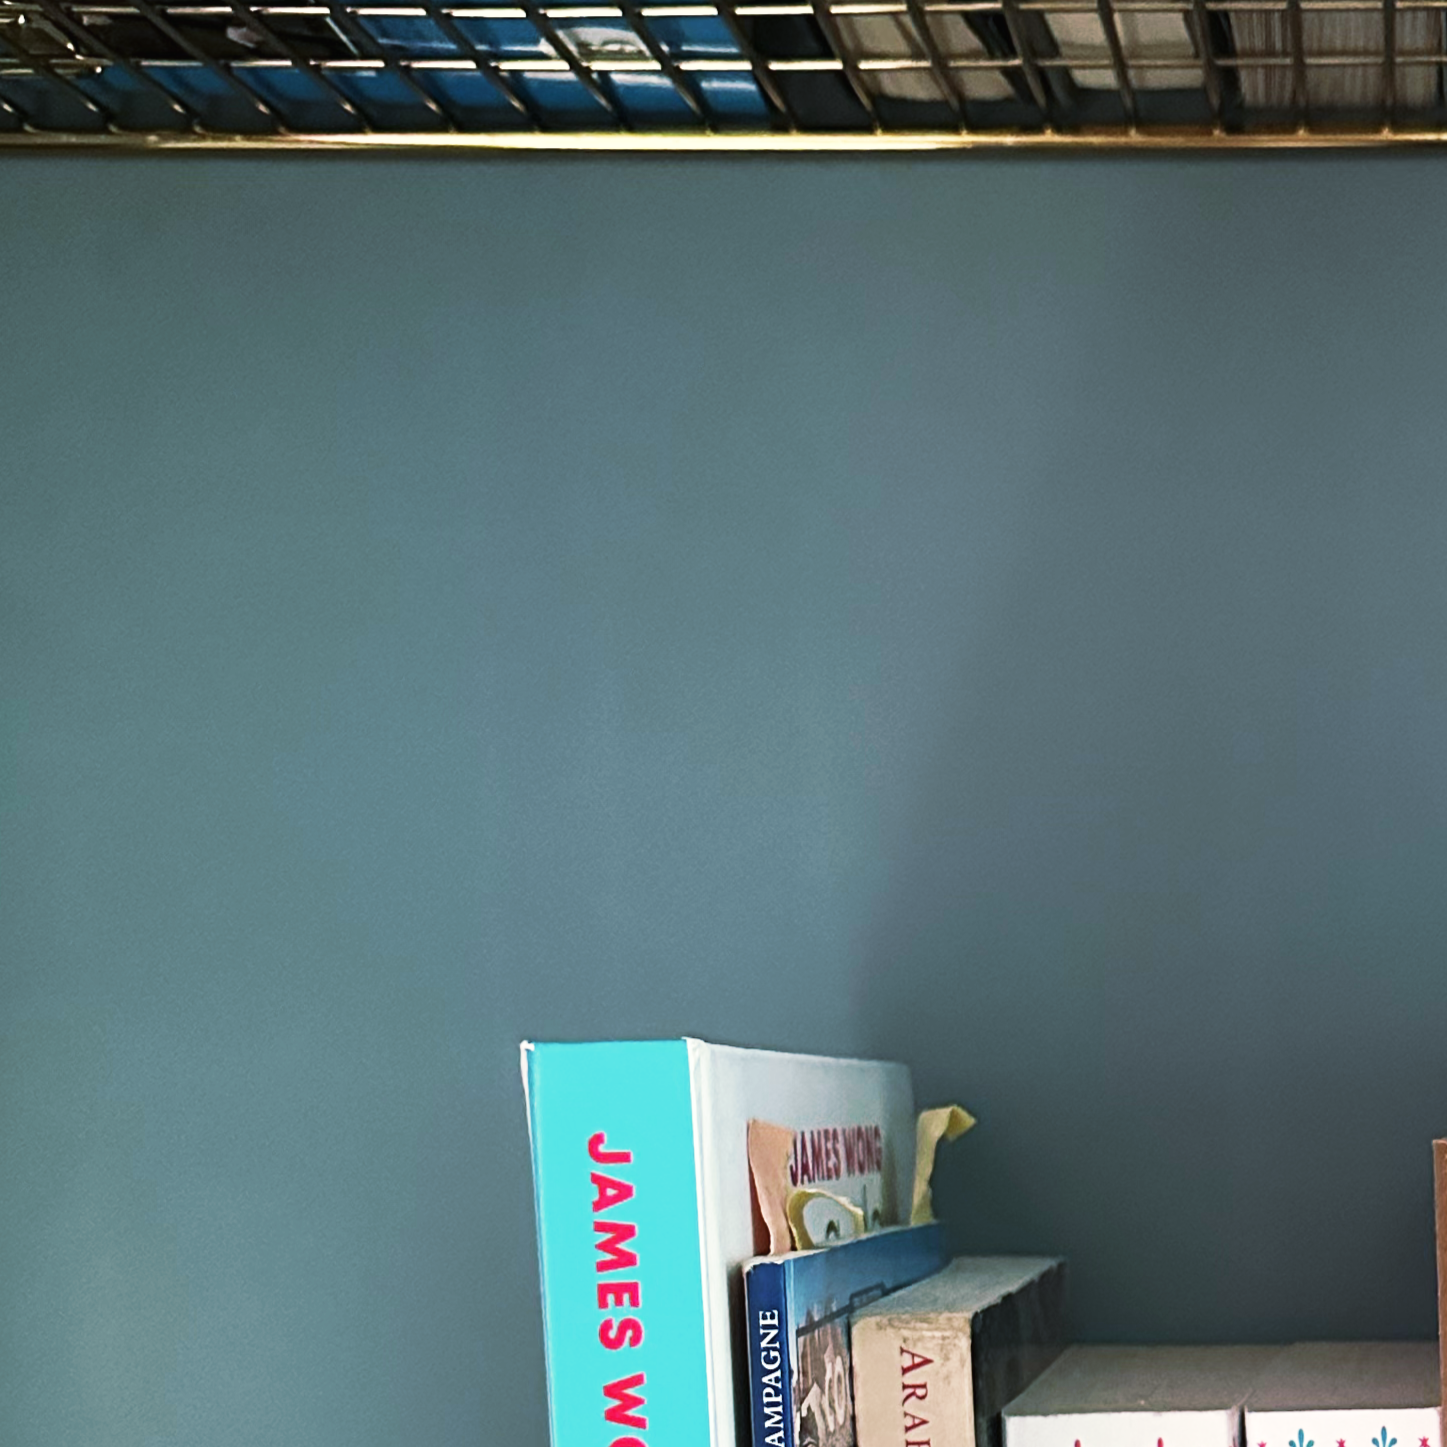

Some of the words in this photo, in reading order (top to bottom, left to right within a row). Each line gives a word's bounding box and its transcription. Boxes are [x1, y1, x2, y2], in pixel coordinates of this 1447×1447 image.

[789, 1127, 841, 1188] JAMES
[842, 1124, 882, 1177] WONG
[588, 1132, 643, 1351] JAMES
